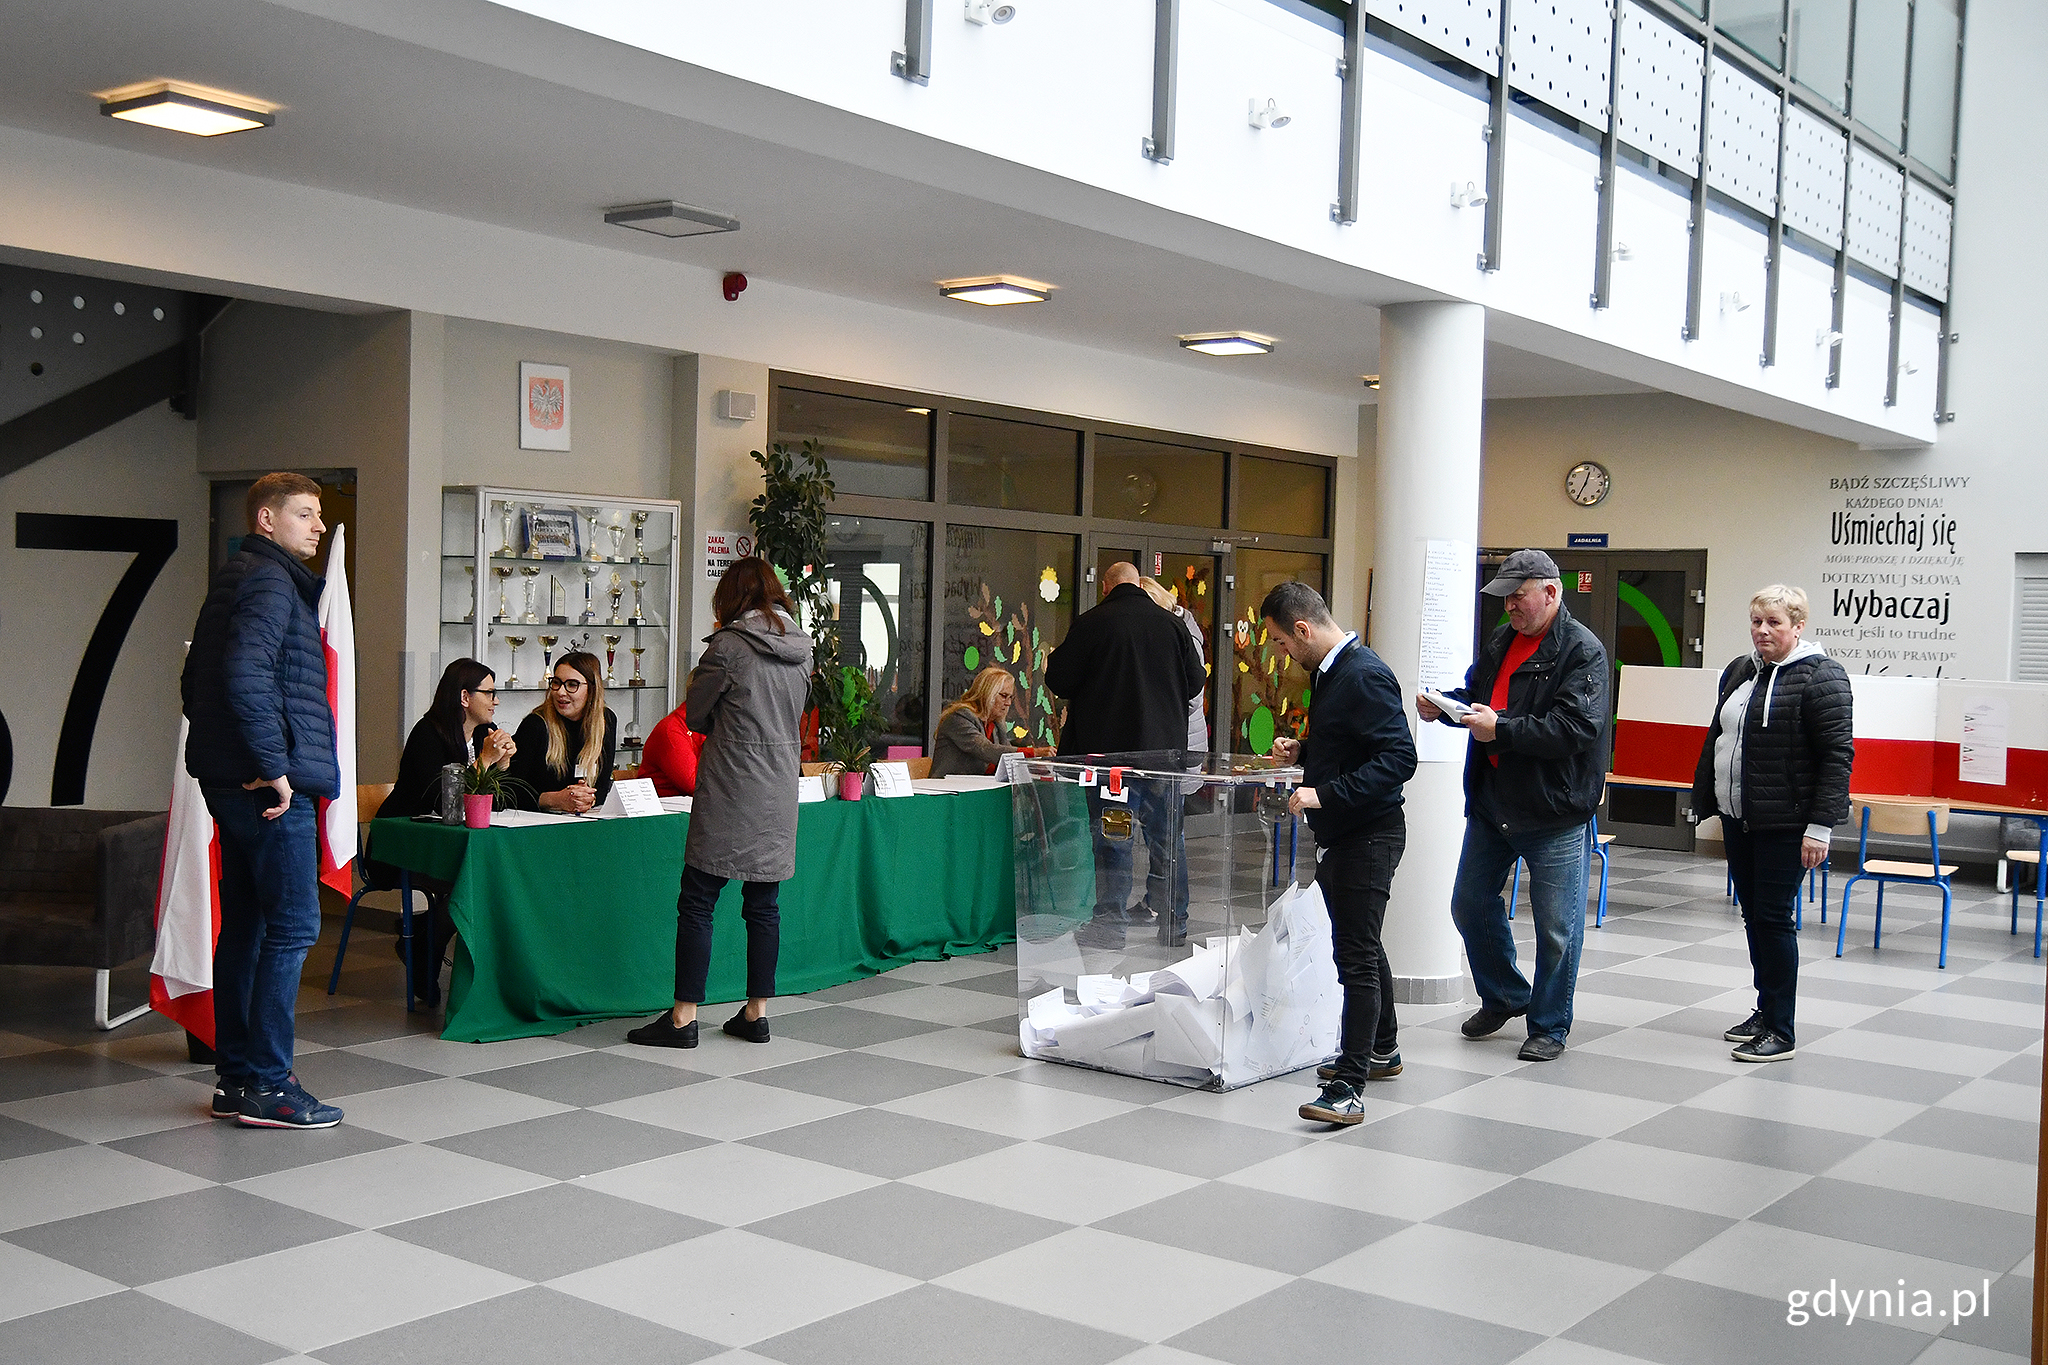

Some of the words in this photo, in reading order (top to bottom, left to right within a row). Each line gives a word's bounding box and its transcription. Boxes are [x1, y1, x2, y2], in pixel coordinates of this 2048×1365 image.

[1829, 474, 1870, 492] BĄDŹ
[1873, 474, 1971, 491] SZCZĘŚLIWY
[1845, 497, 1904, 509] KAŻDEGO
[1907, 497, 1944, 509] DNIA!
[1831, 511, 1925, 552] Uśmiechaj
[1932, 513, 1957, 554] się
[707, 558, 716, 567] NA
[1907, 555, 1966, 568] DZIĘKUJĘ
[1822, 572, 1907, 588] DOTRZYMUJ
[1911, 574, 1962, 586] SŁOWA
[1833, 588, 1951, 626] Wybaczaj
[1815, 626, 1855, 637] nawet
[1857, 625, 1886, 641] jeśli
[1889, 629, 1904, 640] to
[1907, 627, 1957, 641] trudne
[0, 512, 178, 807] 7
[1866, 646, 1900, 660] MÓW
